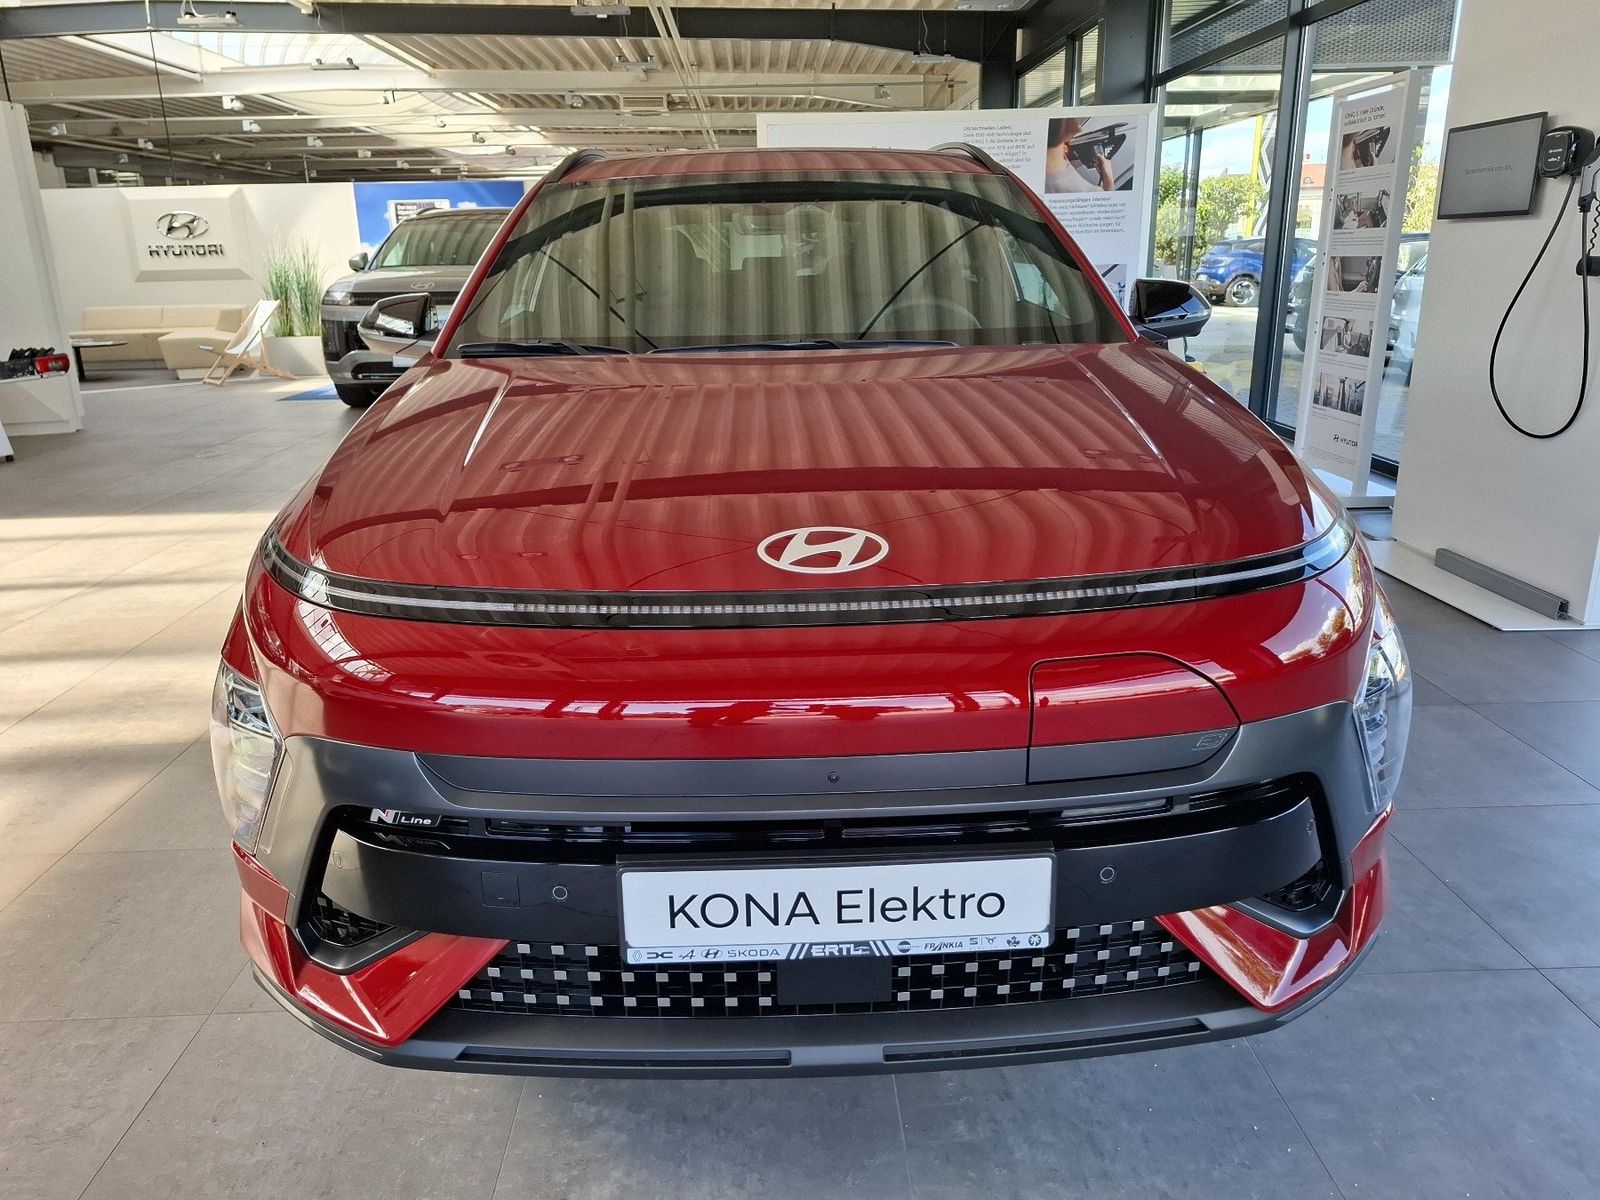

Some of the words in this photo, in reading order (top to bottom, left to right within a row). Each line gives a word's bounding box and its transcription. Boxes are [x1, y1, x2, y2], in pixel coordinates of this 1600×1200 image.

[148, 244, 225, 257] HYUNDAI
[370, 808, 395, 824] N
[400, 816, 432, 825] Line
[668, 891, 820, 929] KONA
[837, 885, 1006, 924] Elektro
[811, 943, 862, 957] ERTL
[924, 940, 964, 951] FRANKIA
